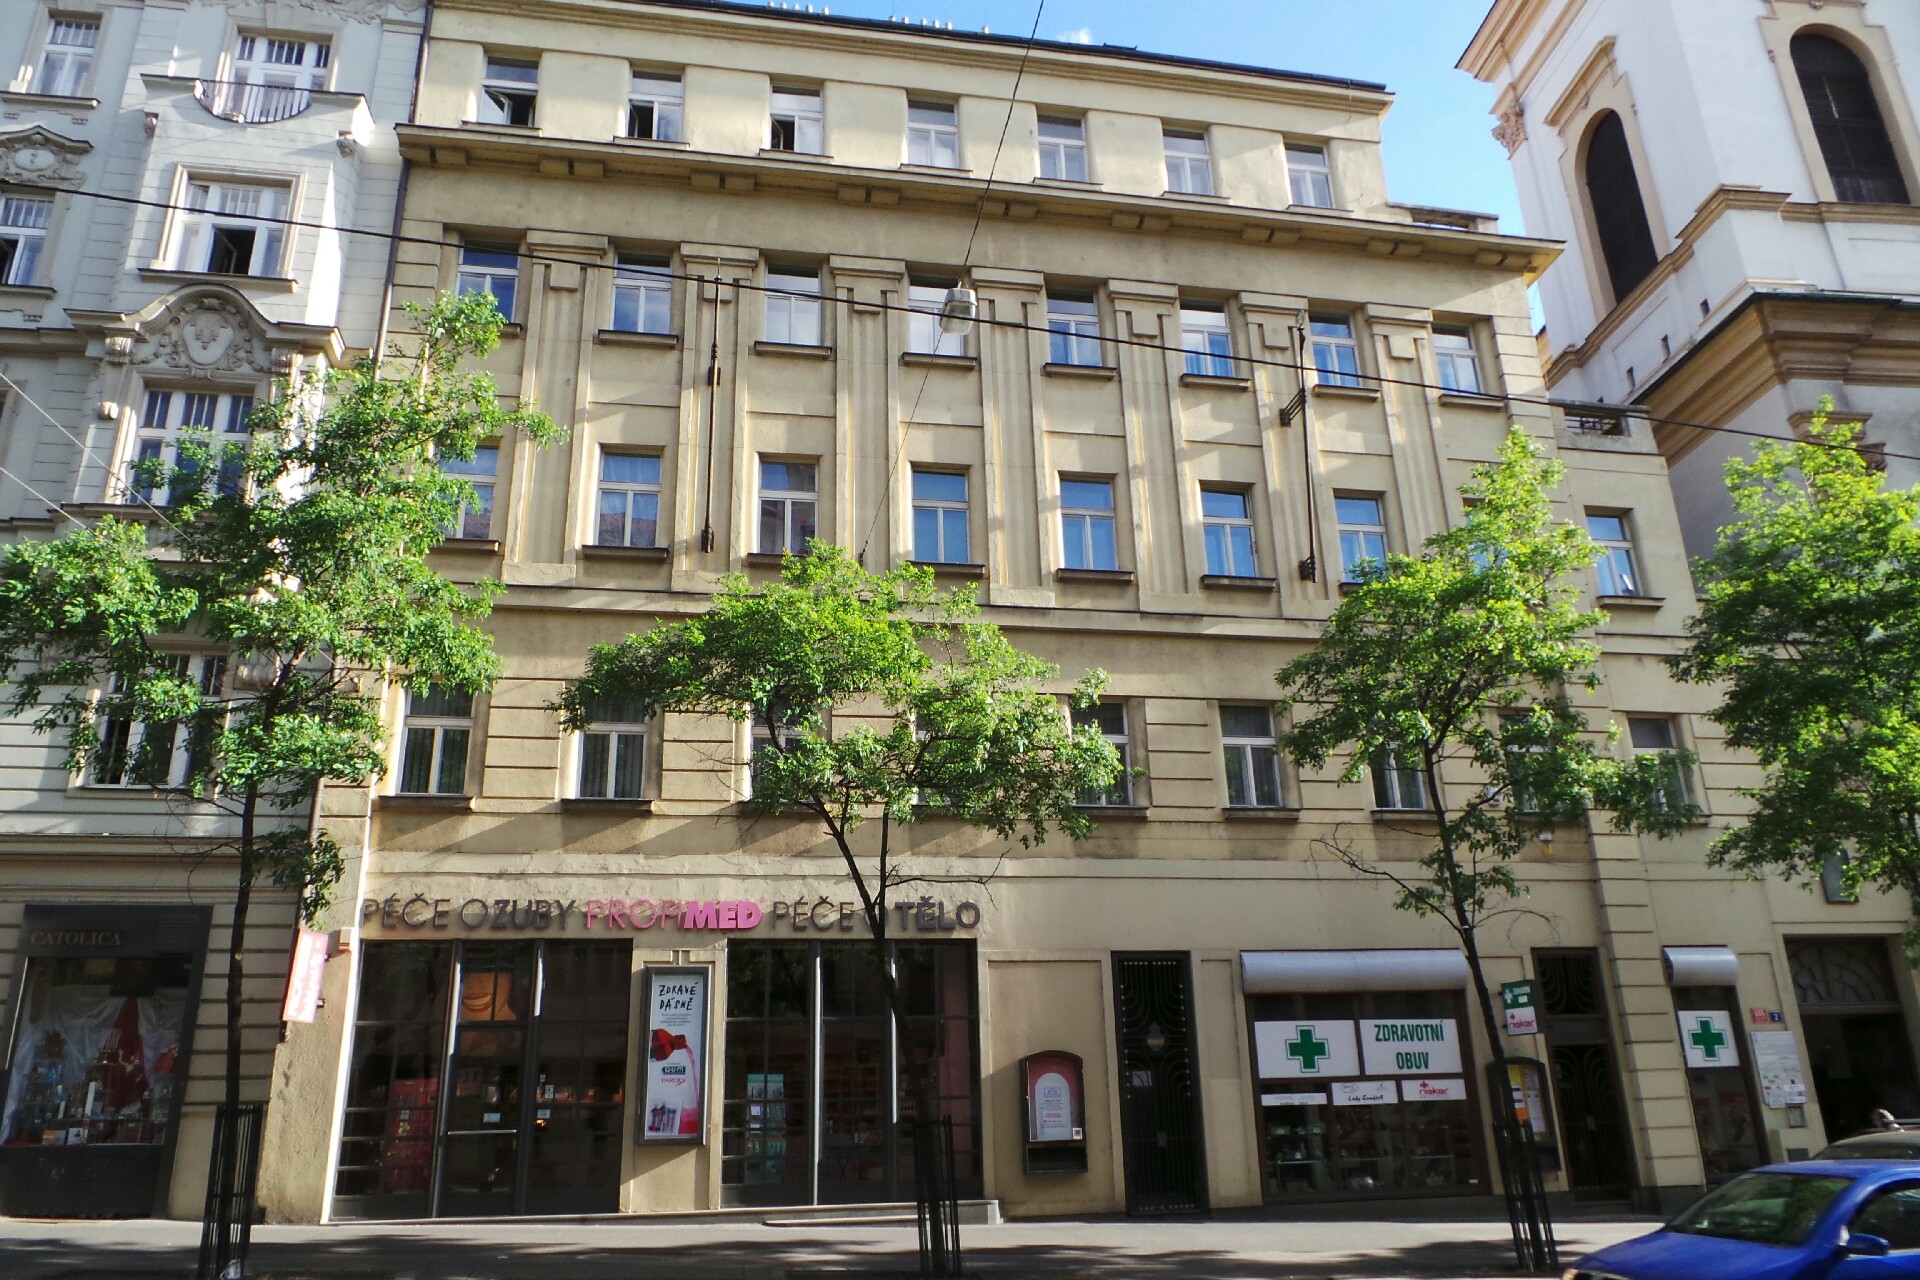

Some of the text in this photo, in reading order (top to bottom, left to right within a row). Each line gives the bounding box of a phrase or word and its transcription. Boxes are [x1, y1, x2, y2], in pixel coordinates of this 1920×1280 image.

[362, 893, 450, 930] PÉČE
[585, 899, 763, 930] PROFIMED
[772, 896, 854, 930] PÉČE
[895, 895, 981, 930] TĚLO
[31, 931, 121, 946] CATOLICA
[658, 981, 700, 997] ZDRAVÉ
[659, 996, 694, 1012] DÁSNĚ
[1374, 1020, 1445, 1043] ZDRAVOTNÍ
[1395, 1051, 1430, 1070] OBUV
